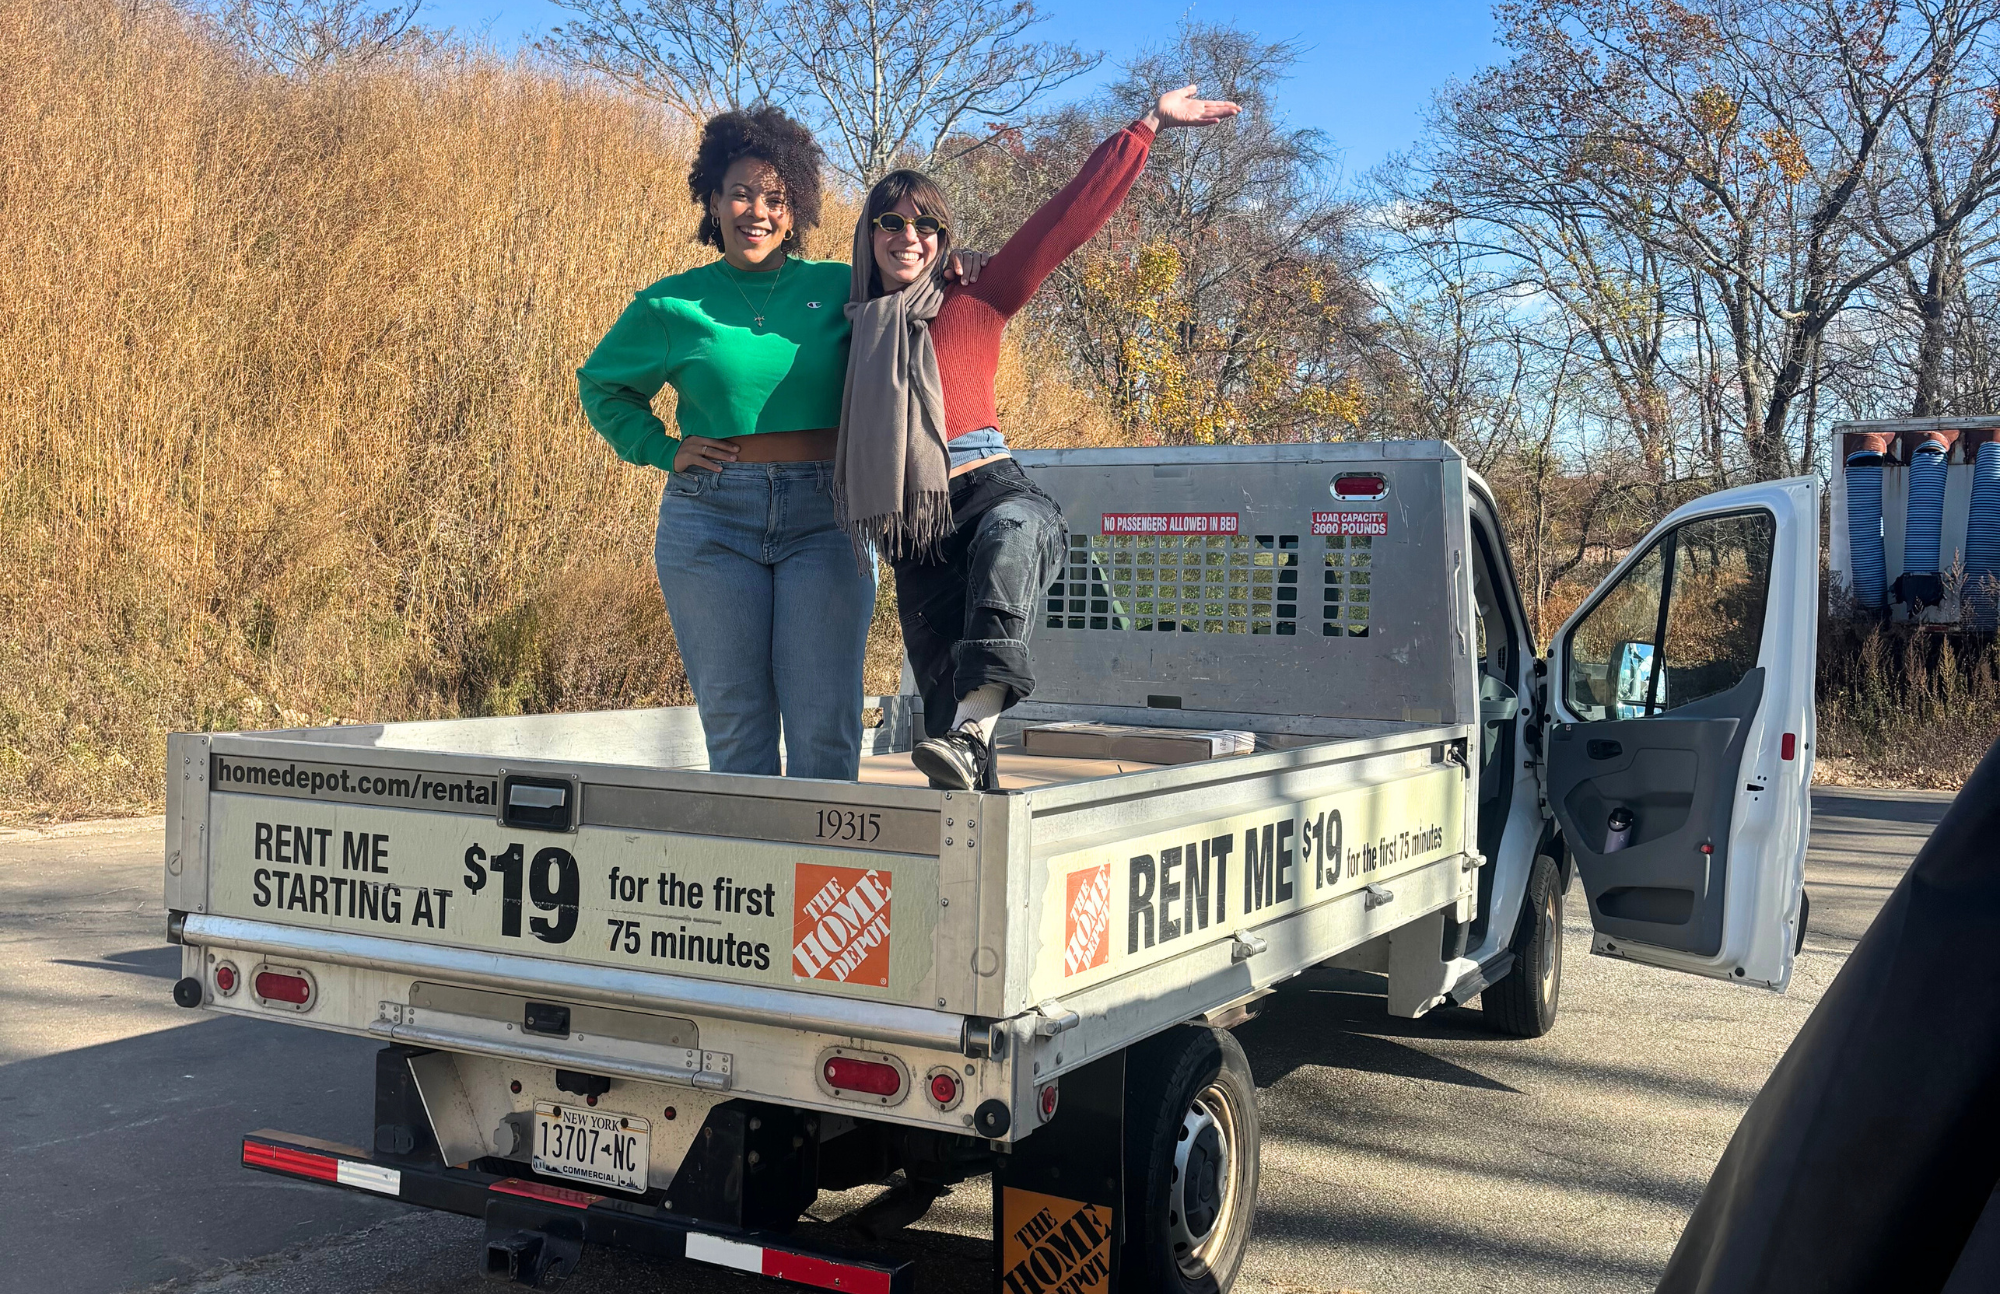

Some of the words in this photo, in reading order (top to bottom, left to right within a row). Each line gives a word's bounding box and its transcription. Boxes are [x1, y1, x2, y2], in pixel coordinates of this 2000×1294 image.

[1104, 516, 1115, 531] NO
[1117, 516, 1167, 531] PASSENGERS
[1169, 516, 1207, 531] ALLOWED
[1209, 516, 1218, 531] IN
[1220, 516, 1237, 531] BED
[1316, 513, 1340, 523] LOAD
[1341, 513, 1384, 522] CAPACITY
[1341, 523, 1386, 534] POUNDS
[218, 758, 497, 805] homedepot.com/rental
[255, 822, 333, 867] RENT
[342, 831, 390, 874] ME
[815, 809, 881, 843] 19315
[1302, 808, 1343, 891] $19
[1347, 847, 1360, 879] for
[1363, 842, 1377, 874] the
[1379, 834, 1397, 868] first
[1400, 831, 1409, 861] 75
[1412, 823, 1443, 857] minutes
[253, 868, 402, 924] STARTING
[411, 887, 453, 930] AT
[463, 842, 580, 944] $19
[608, 866, 649, 903] for
[657, 872, 704, 909] the
[712, 877, 776, 917] first
[803, 876, 845, 922] THE
[1069, 878, 1091, 924] THE
[1128, 833, 1234, 956] RENT
[1244, 818, 1294, 915] ME
[793, 869, 892, 979] HOME
[1065, 865, 1110, 974] HOME
[607, 919, 642, 955] 75
[650, 926, 771, 971] minutes
[829, 913, 891, 983] DEPOT
[542, 1122, 599, 1164] 13707
[613, 1133, 636, 1172] NC
[563, 1112, 588, 1126] NEW
[592, 1115, 620, 1132] YORK
[563, 1165, 615, 1182] COMMERCIAL
[1003, 1202, 1112, 1294] HOME
[1013, 1206, 1059, 1251] THE
